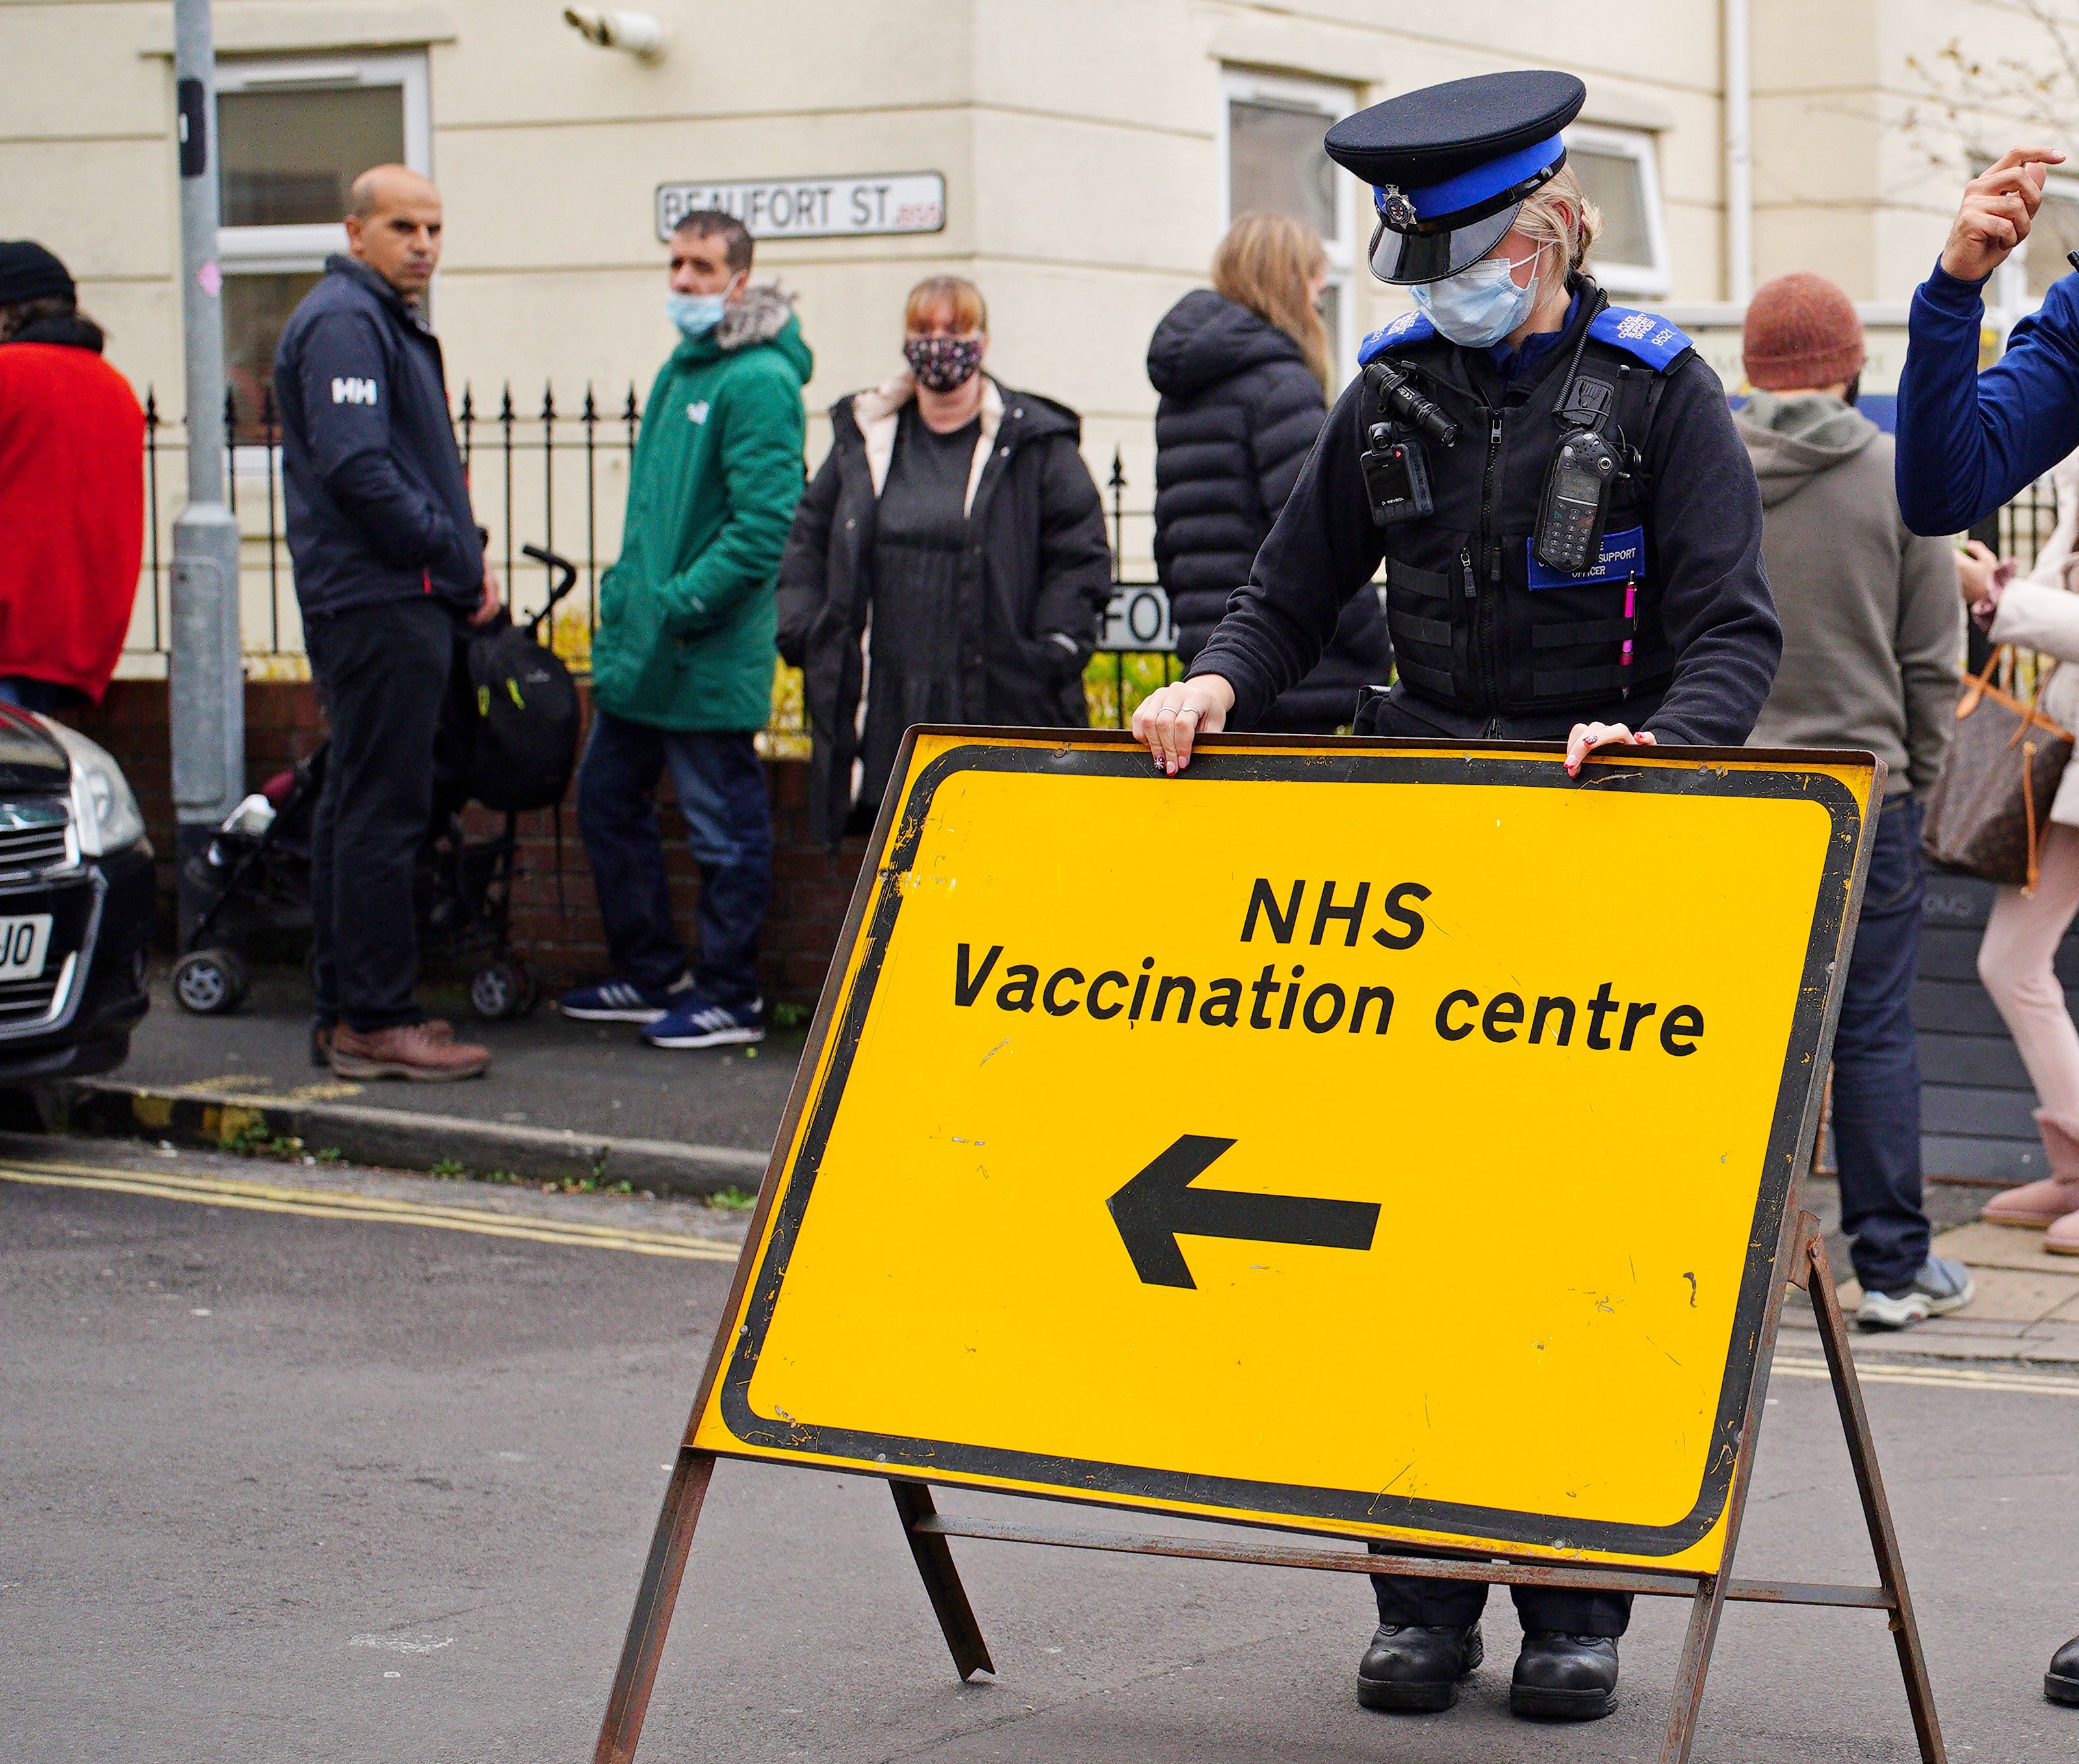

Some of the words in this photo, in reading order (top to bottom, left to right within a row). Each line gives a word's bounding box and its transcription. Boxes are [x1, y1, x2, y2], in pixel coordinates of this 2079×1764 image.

[850, 185, 891, 226] ST
[1616, 314, 1636, 331] POLICE
[1651, 328, 1676, 346] 9521
[1598, 548, 1636, 563] SUPPORT
[1102, 592, 1172, 642] FO
[1241, 878, 1431, 949] NHS
[955, 943, 1394, 1034] Vaccination
[1436, 983, 1703, 1056] centre
